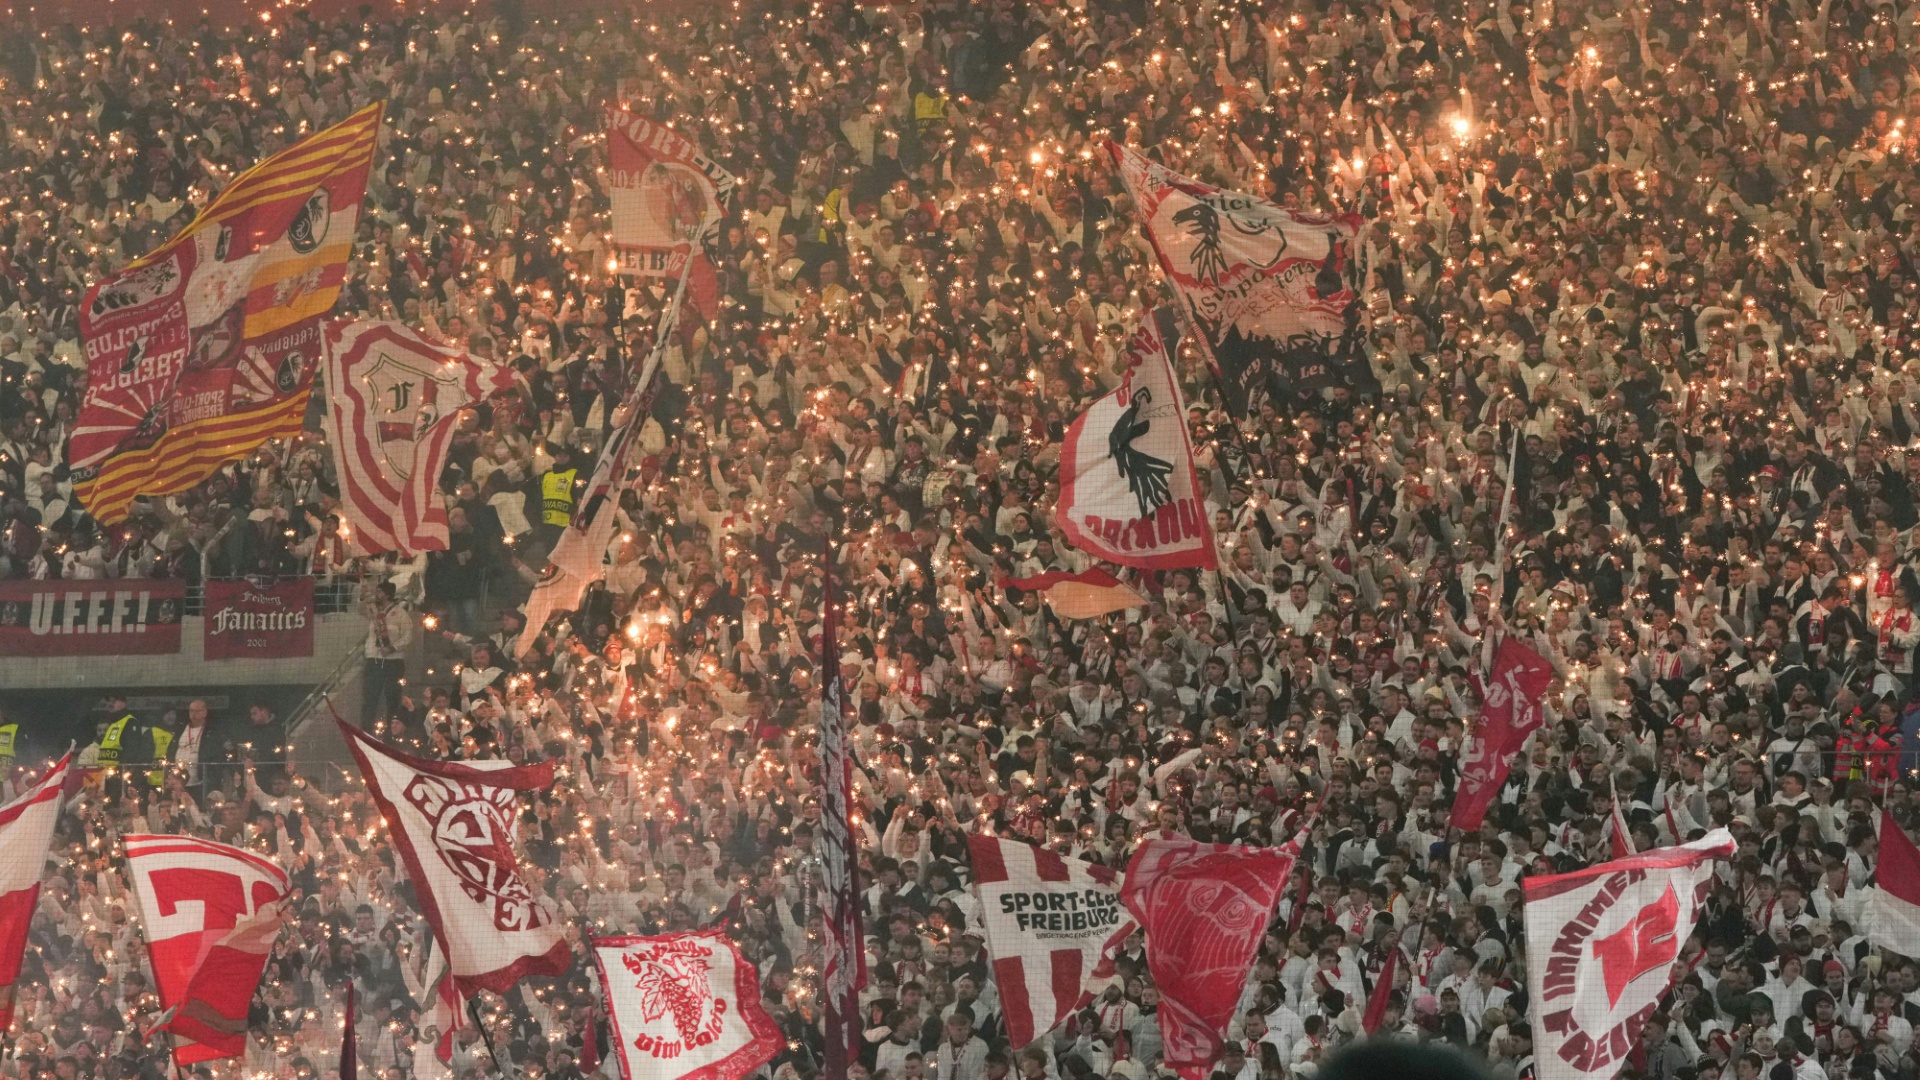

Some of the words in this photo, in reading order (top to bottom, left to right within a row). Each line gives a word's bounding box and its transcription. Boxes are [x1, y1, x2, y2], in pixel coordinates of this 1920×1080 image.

[29, 591, 150, 636] U.F.F.F.!
[210, 606, 307, 636] Fanatics
[1016, 906, 1119, 932] FREIBURG
